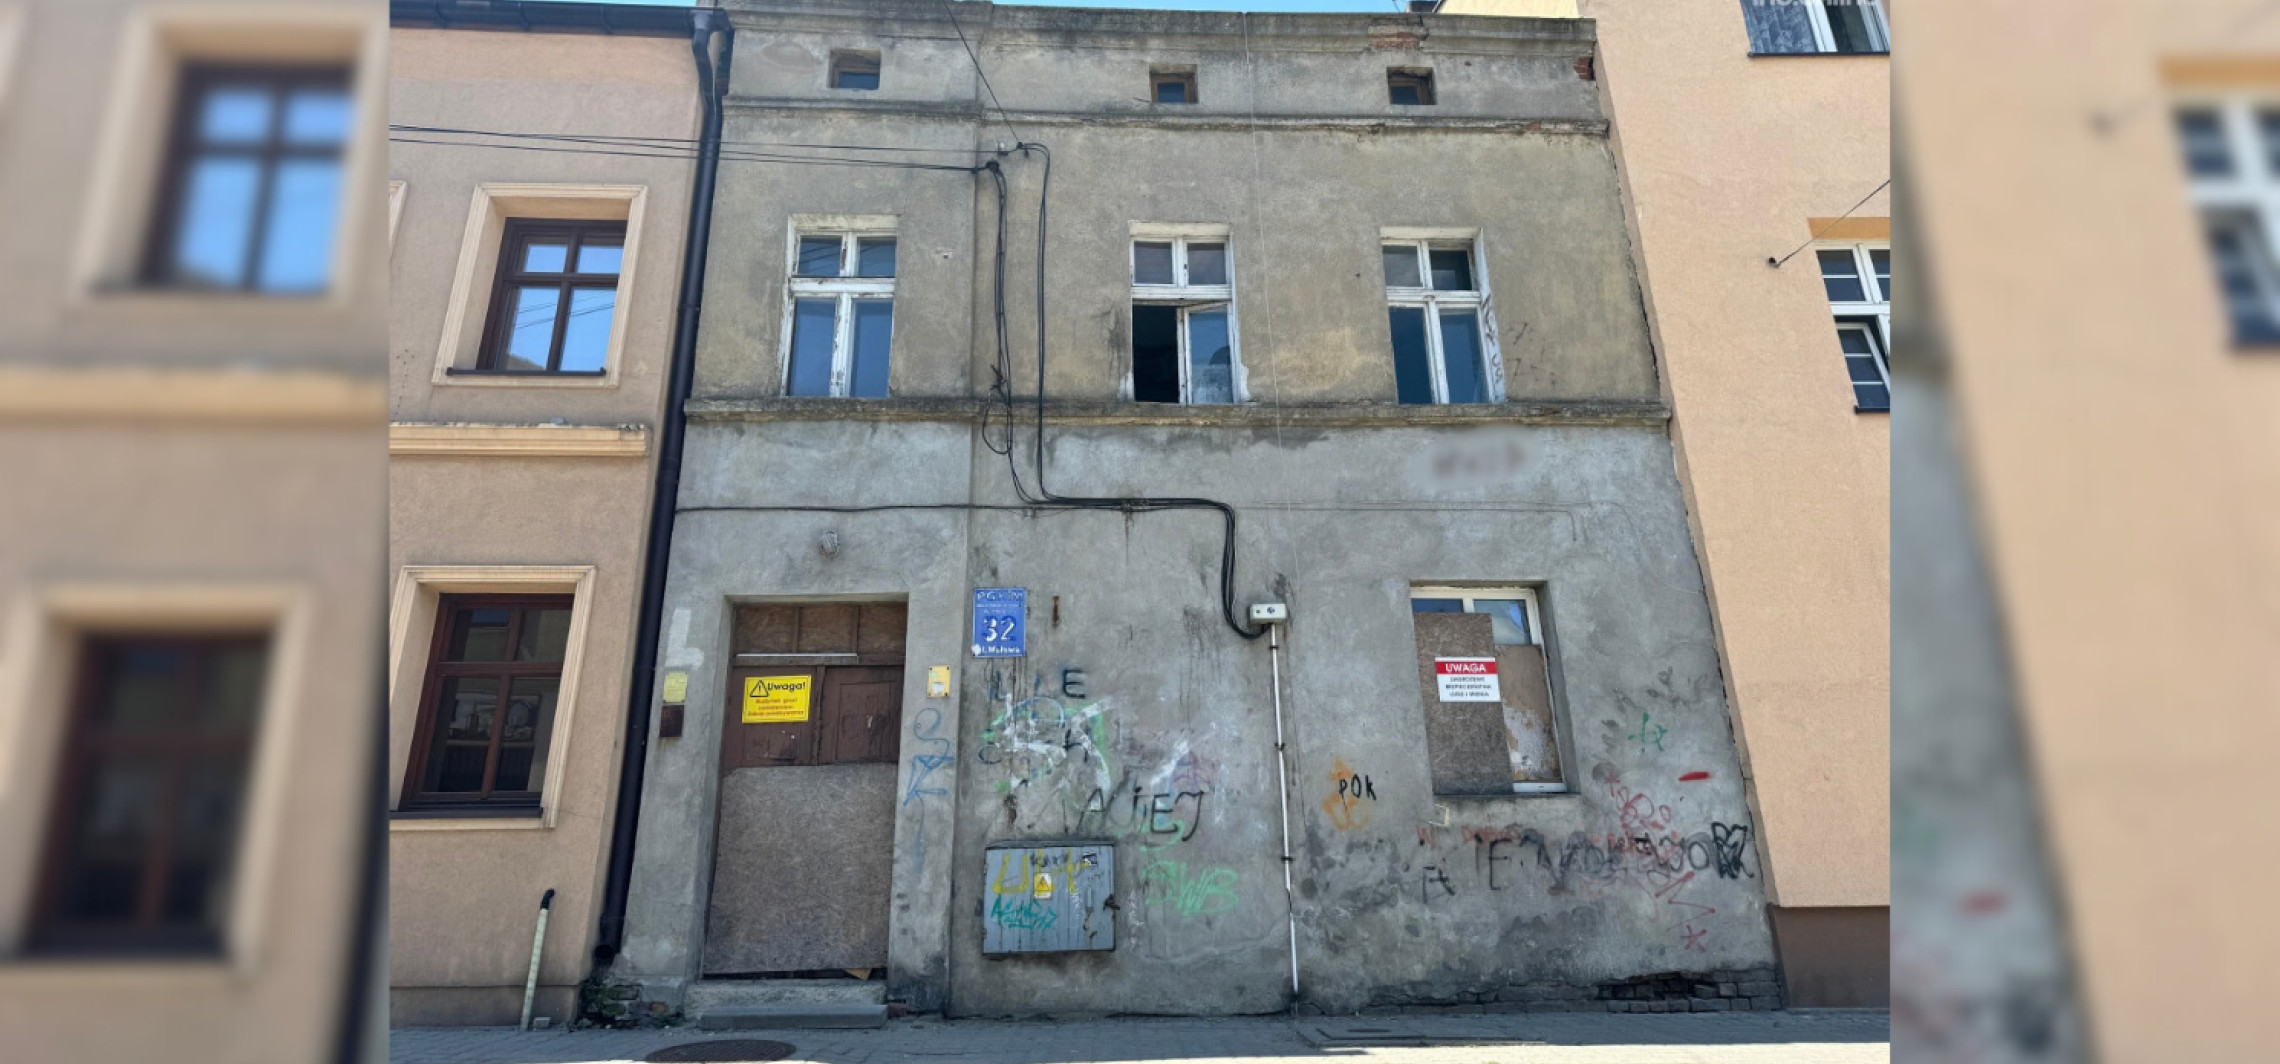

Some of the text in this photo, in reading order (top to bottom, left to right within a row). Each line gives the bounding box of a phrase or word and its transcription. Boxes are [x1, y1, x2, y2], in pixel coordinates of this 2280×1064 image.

[983, 616, 1016, 642] 32
[1445, 664, 1487, 672] UWAGA
[768, 682, 805, 692] Uwaga!
